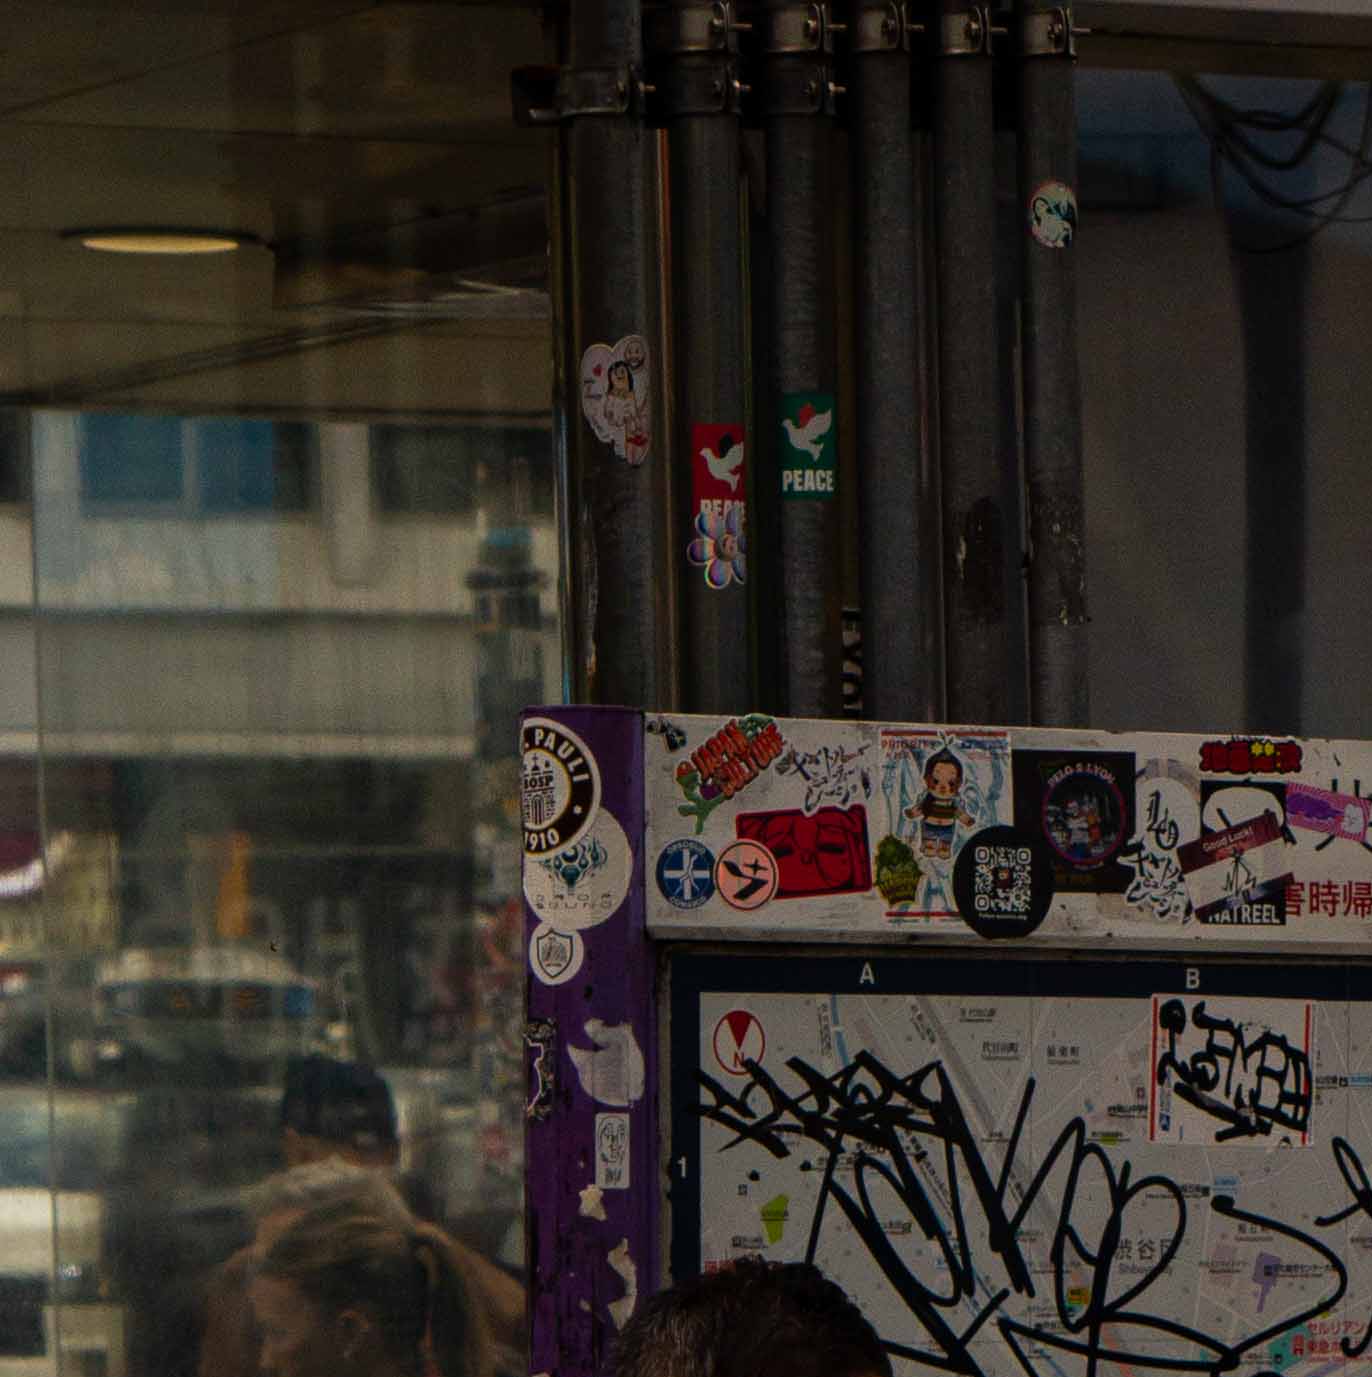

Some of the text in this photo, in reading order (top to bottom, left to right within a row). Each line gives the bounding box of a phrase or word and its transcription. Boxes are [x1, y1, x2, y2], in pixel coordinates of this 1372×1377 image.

[782, 469, 834, 492] PEACE
[533, 727, 591, 784] PAULI
[859, 968, 876, 985] A
[1185, 970, 1200, 990] B
[733, 1052, 746, 1066] N
[676, 1161, 687, 1178] 1
